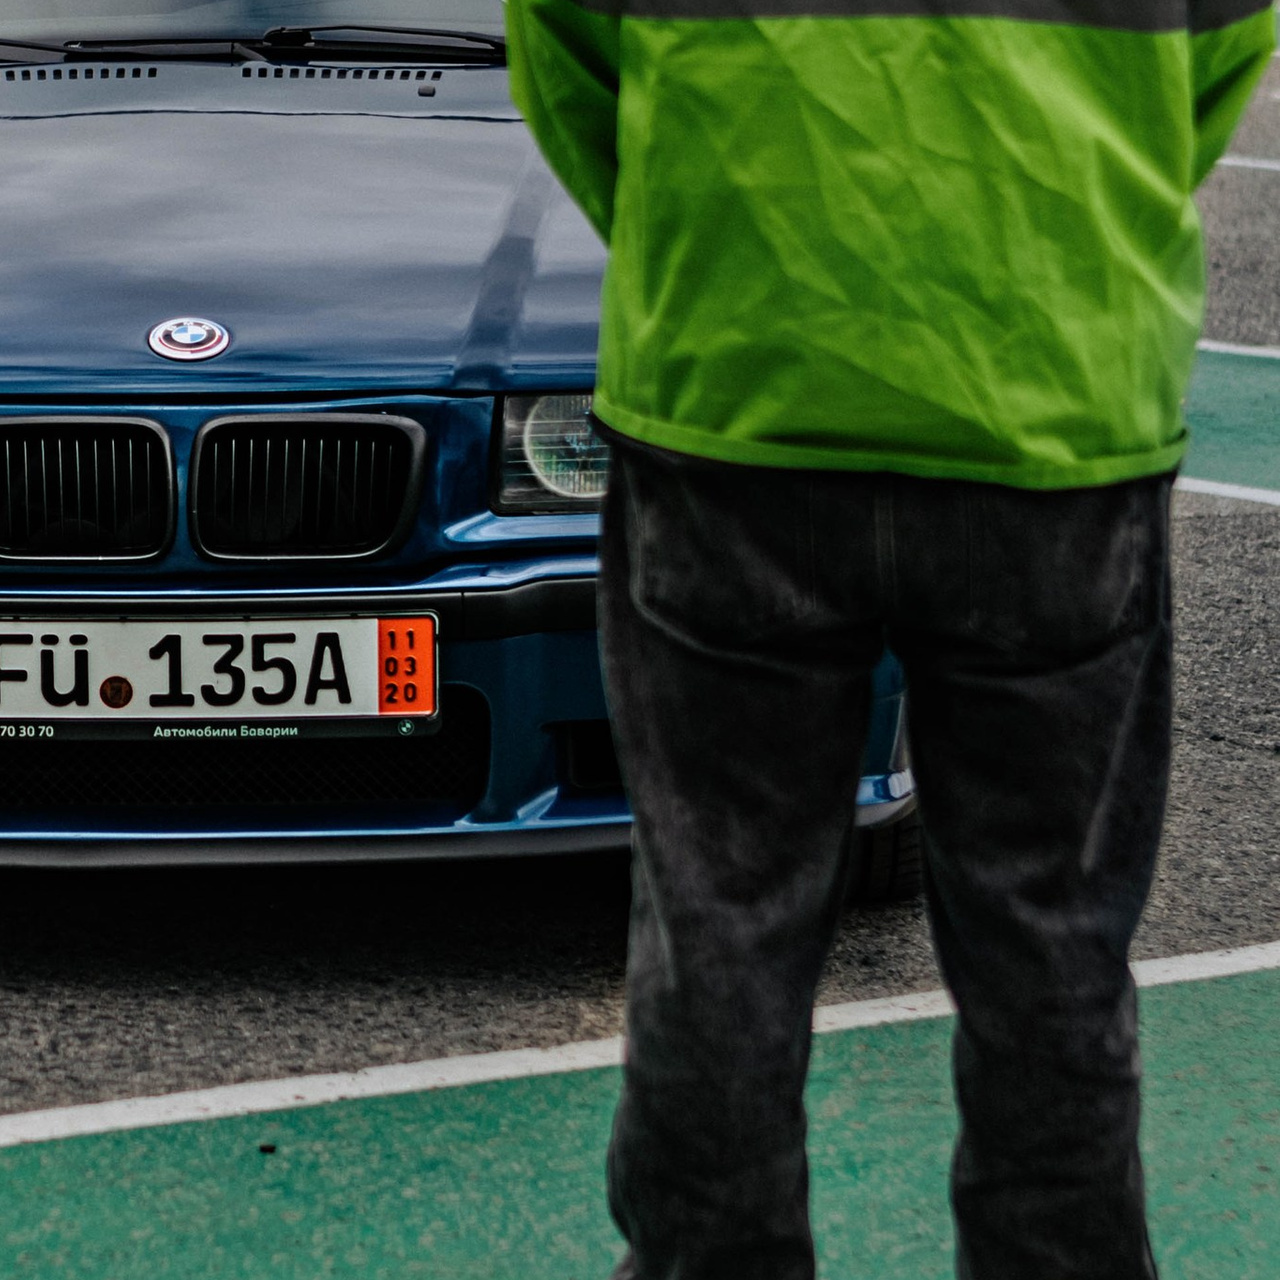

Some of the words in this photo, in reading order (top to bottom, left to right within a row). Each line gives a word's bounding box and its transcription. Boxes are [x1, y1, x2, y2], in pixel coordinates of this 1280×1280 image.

[387, 630, 416, 650] 11
[148, 632, 353, 708] 135A
[384, 656, 417, 677] 03
[384, 682, 417, 704] 20
[18, 725, 35, 737] 30
[38, 725, 55, 737] 70
[153, 725, 238, 738] Автомобили
[240, 724, 299, 738] Баварии
